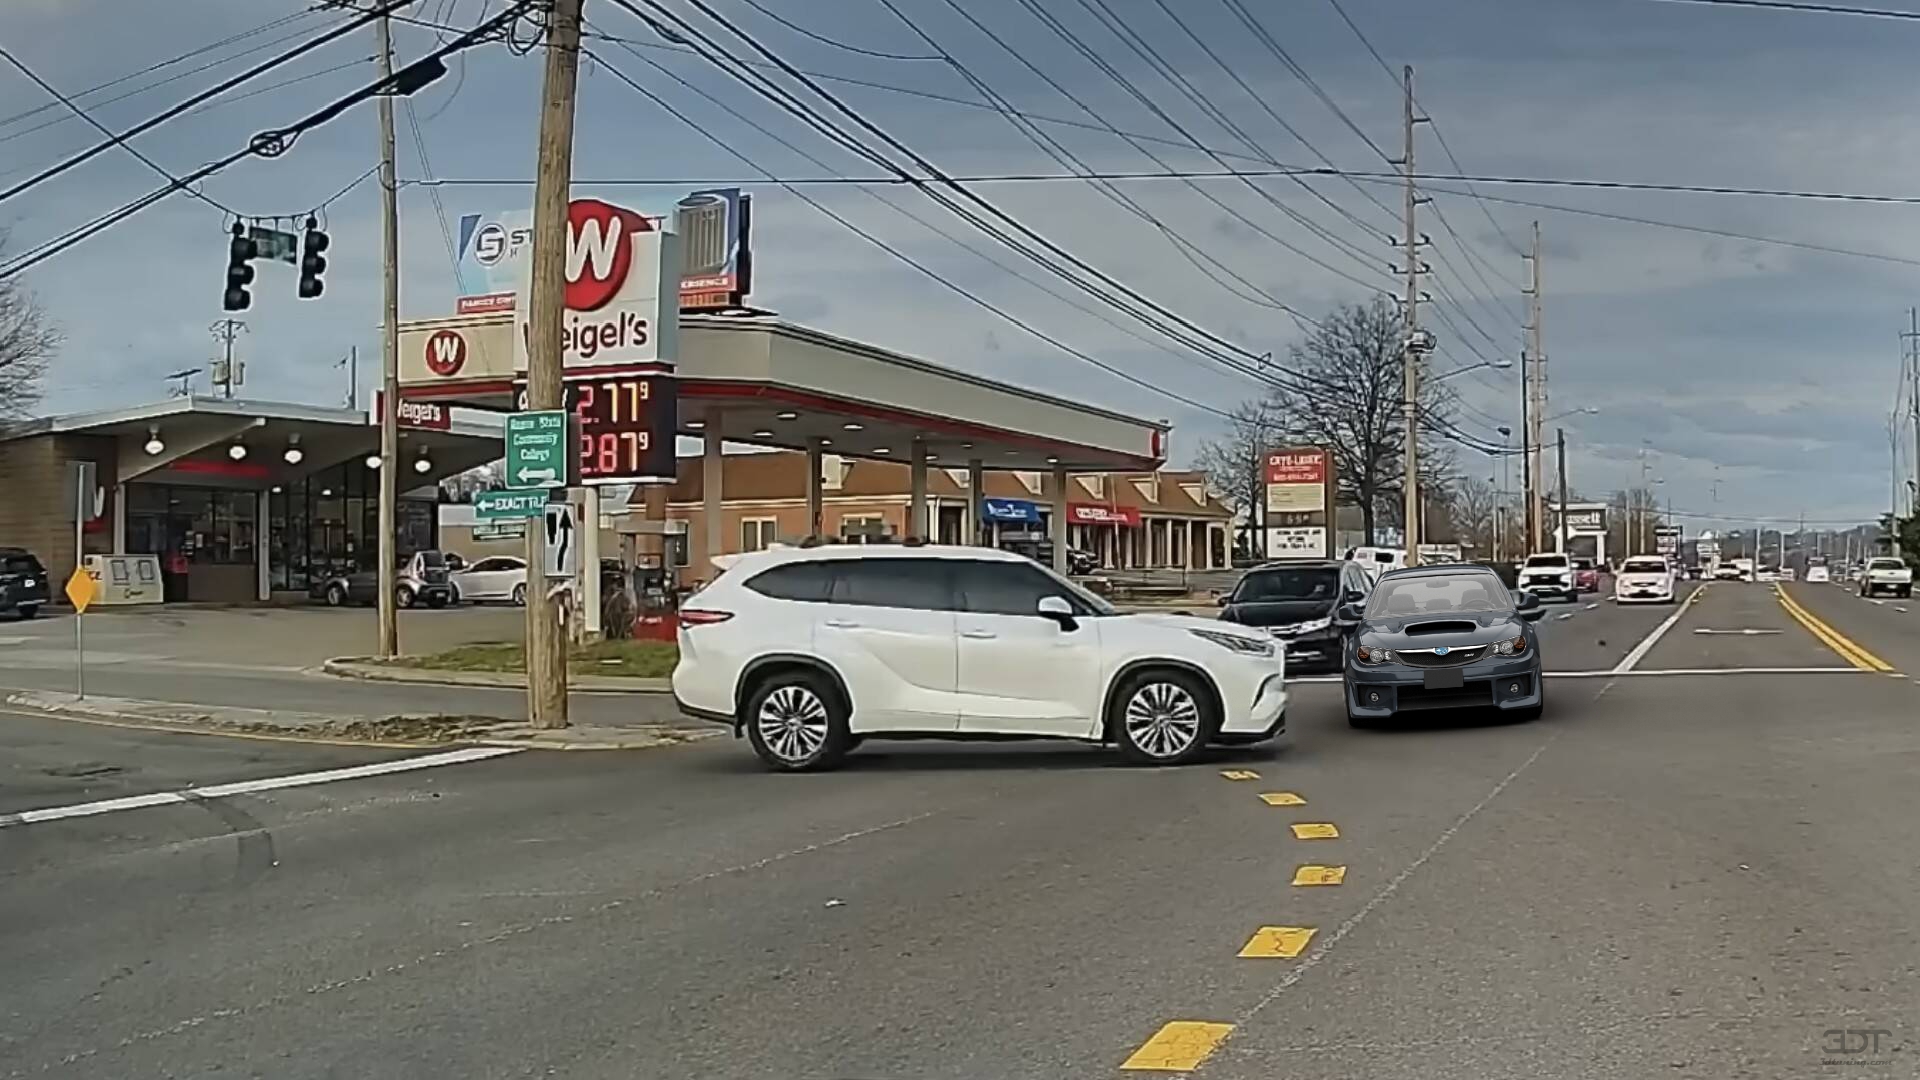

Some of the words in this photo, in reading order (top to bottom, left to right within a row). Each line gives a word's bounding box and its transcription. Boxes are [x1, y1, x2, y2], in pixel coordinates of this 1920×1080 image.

[564, 215, 623, 283] W
[523, 311, 648, 358] eigel's
[434, 336, 459, 363] W
[513, 432, 558, 446] Community
[520, 448, 550, 461] College
[494, 497, 526, 510] EXACT
